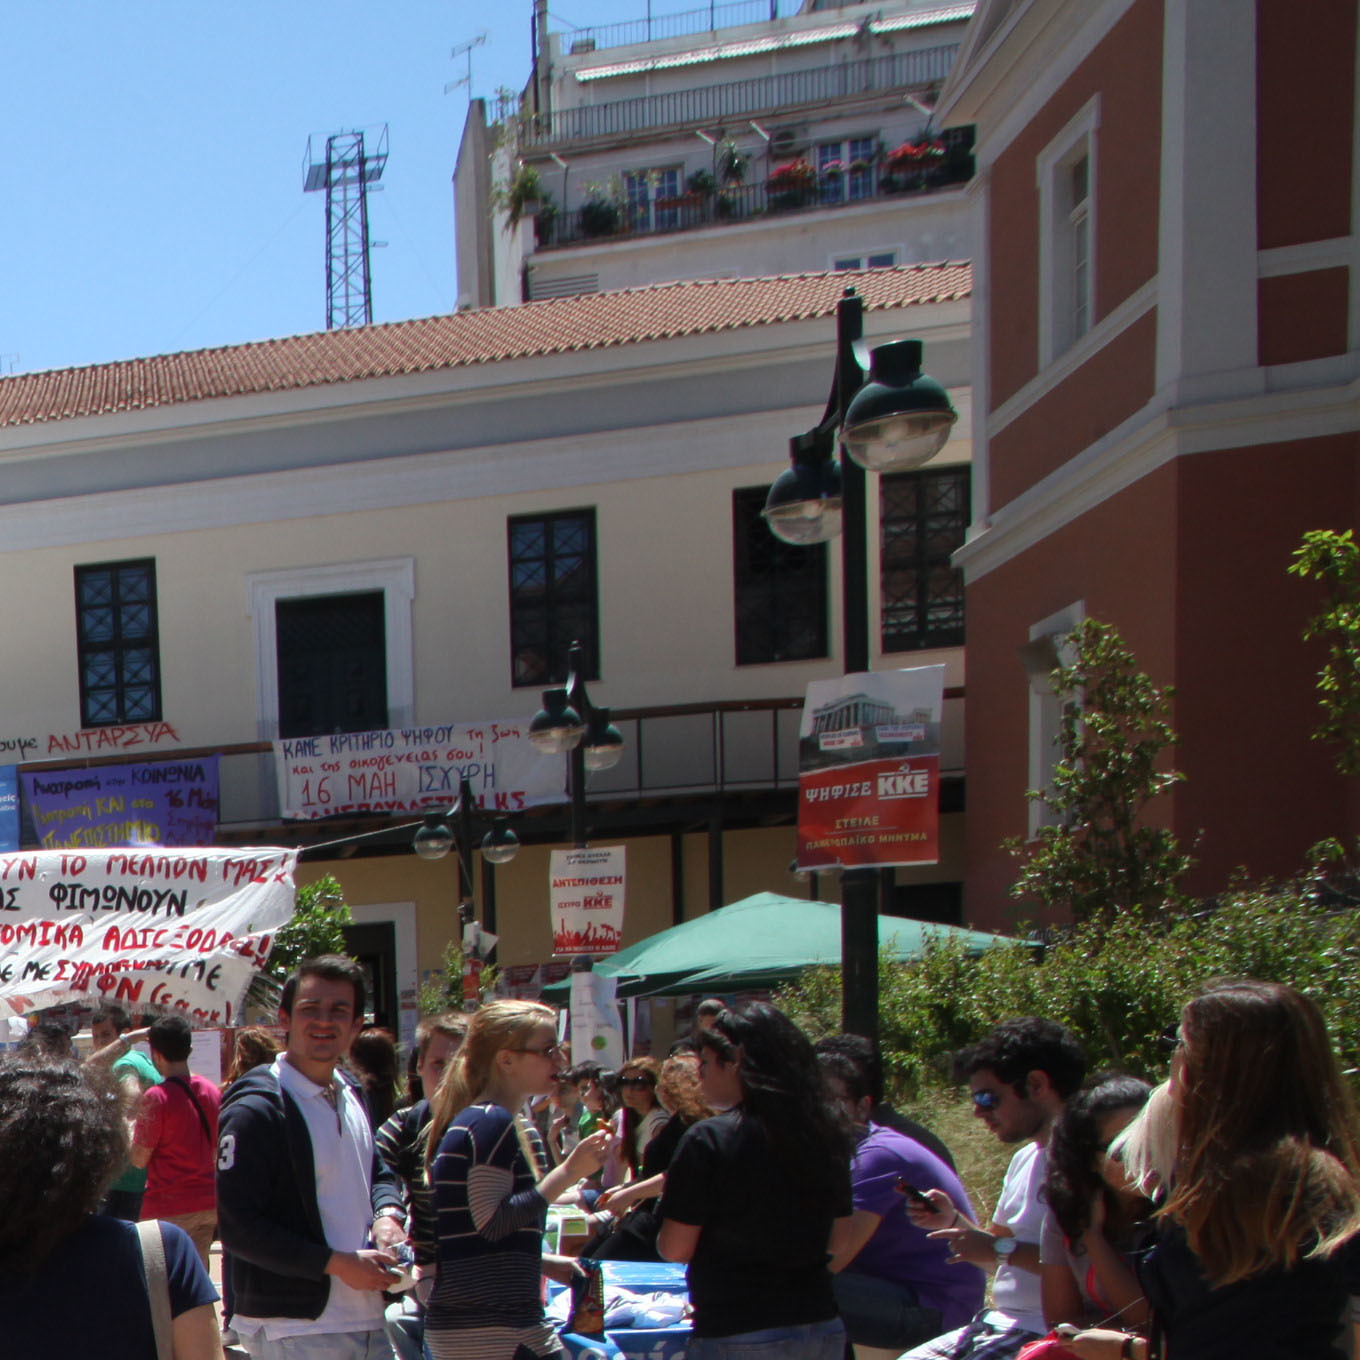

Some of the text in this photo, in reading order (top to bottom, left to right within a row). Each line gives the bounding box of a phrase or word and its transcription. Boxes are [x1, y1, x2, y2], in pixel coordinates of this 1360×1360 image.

[46, 722, 181, 754] ΑΝΤΑΡΣΥΑ
[283, 737, 323, 761] ΚΑΝΕ
[330, 731, 395, 755] ΚΡΙΤΗΡΙΟ
[400, 725, 455, 747] ΨΗΦΟΥ
[300, 776, 331, 806] 16
[347, 772, 397, 801] ΜΑΗ
[804, 773, 929, 803] ΨΗΦΙΣΕ ΚΚΕ
[60, 853, 88, 878] ΤΟ
[48, 881, 188, 918] ΦΙΜΩΝΟΥΝ
[22, 960, 53, 982] ΜΕ
